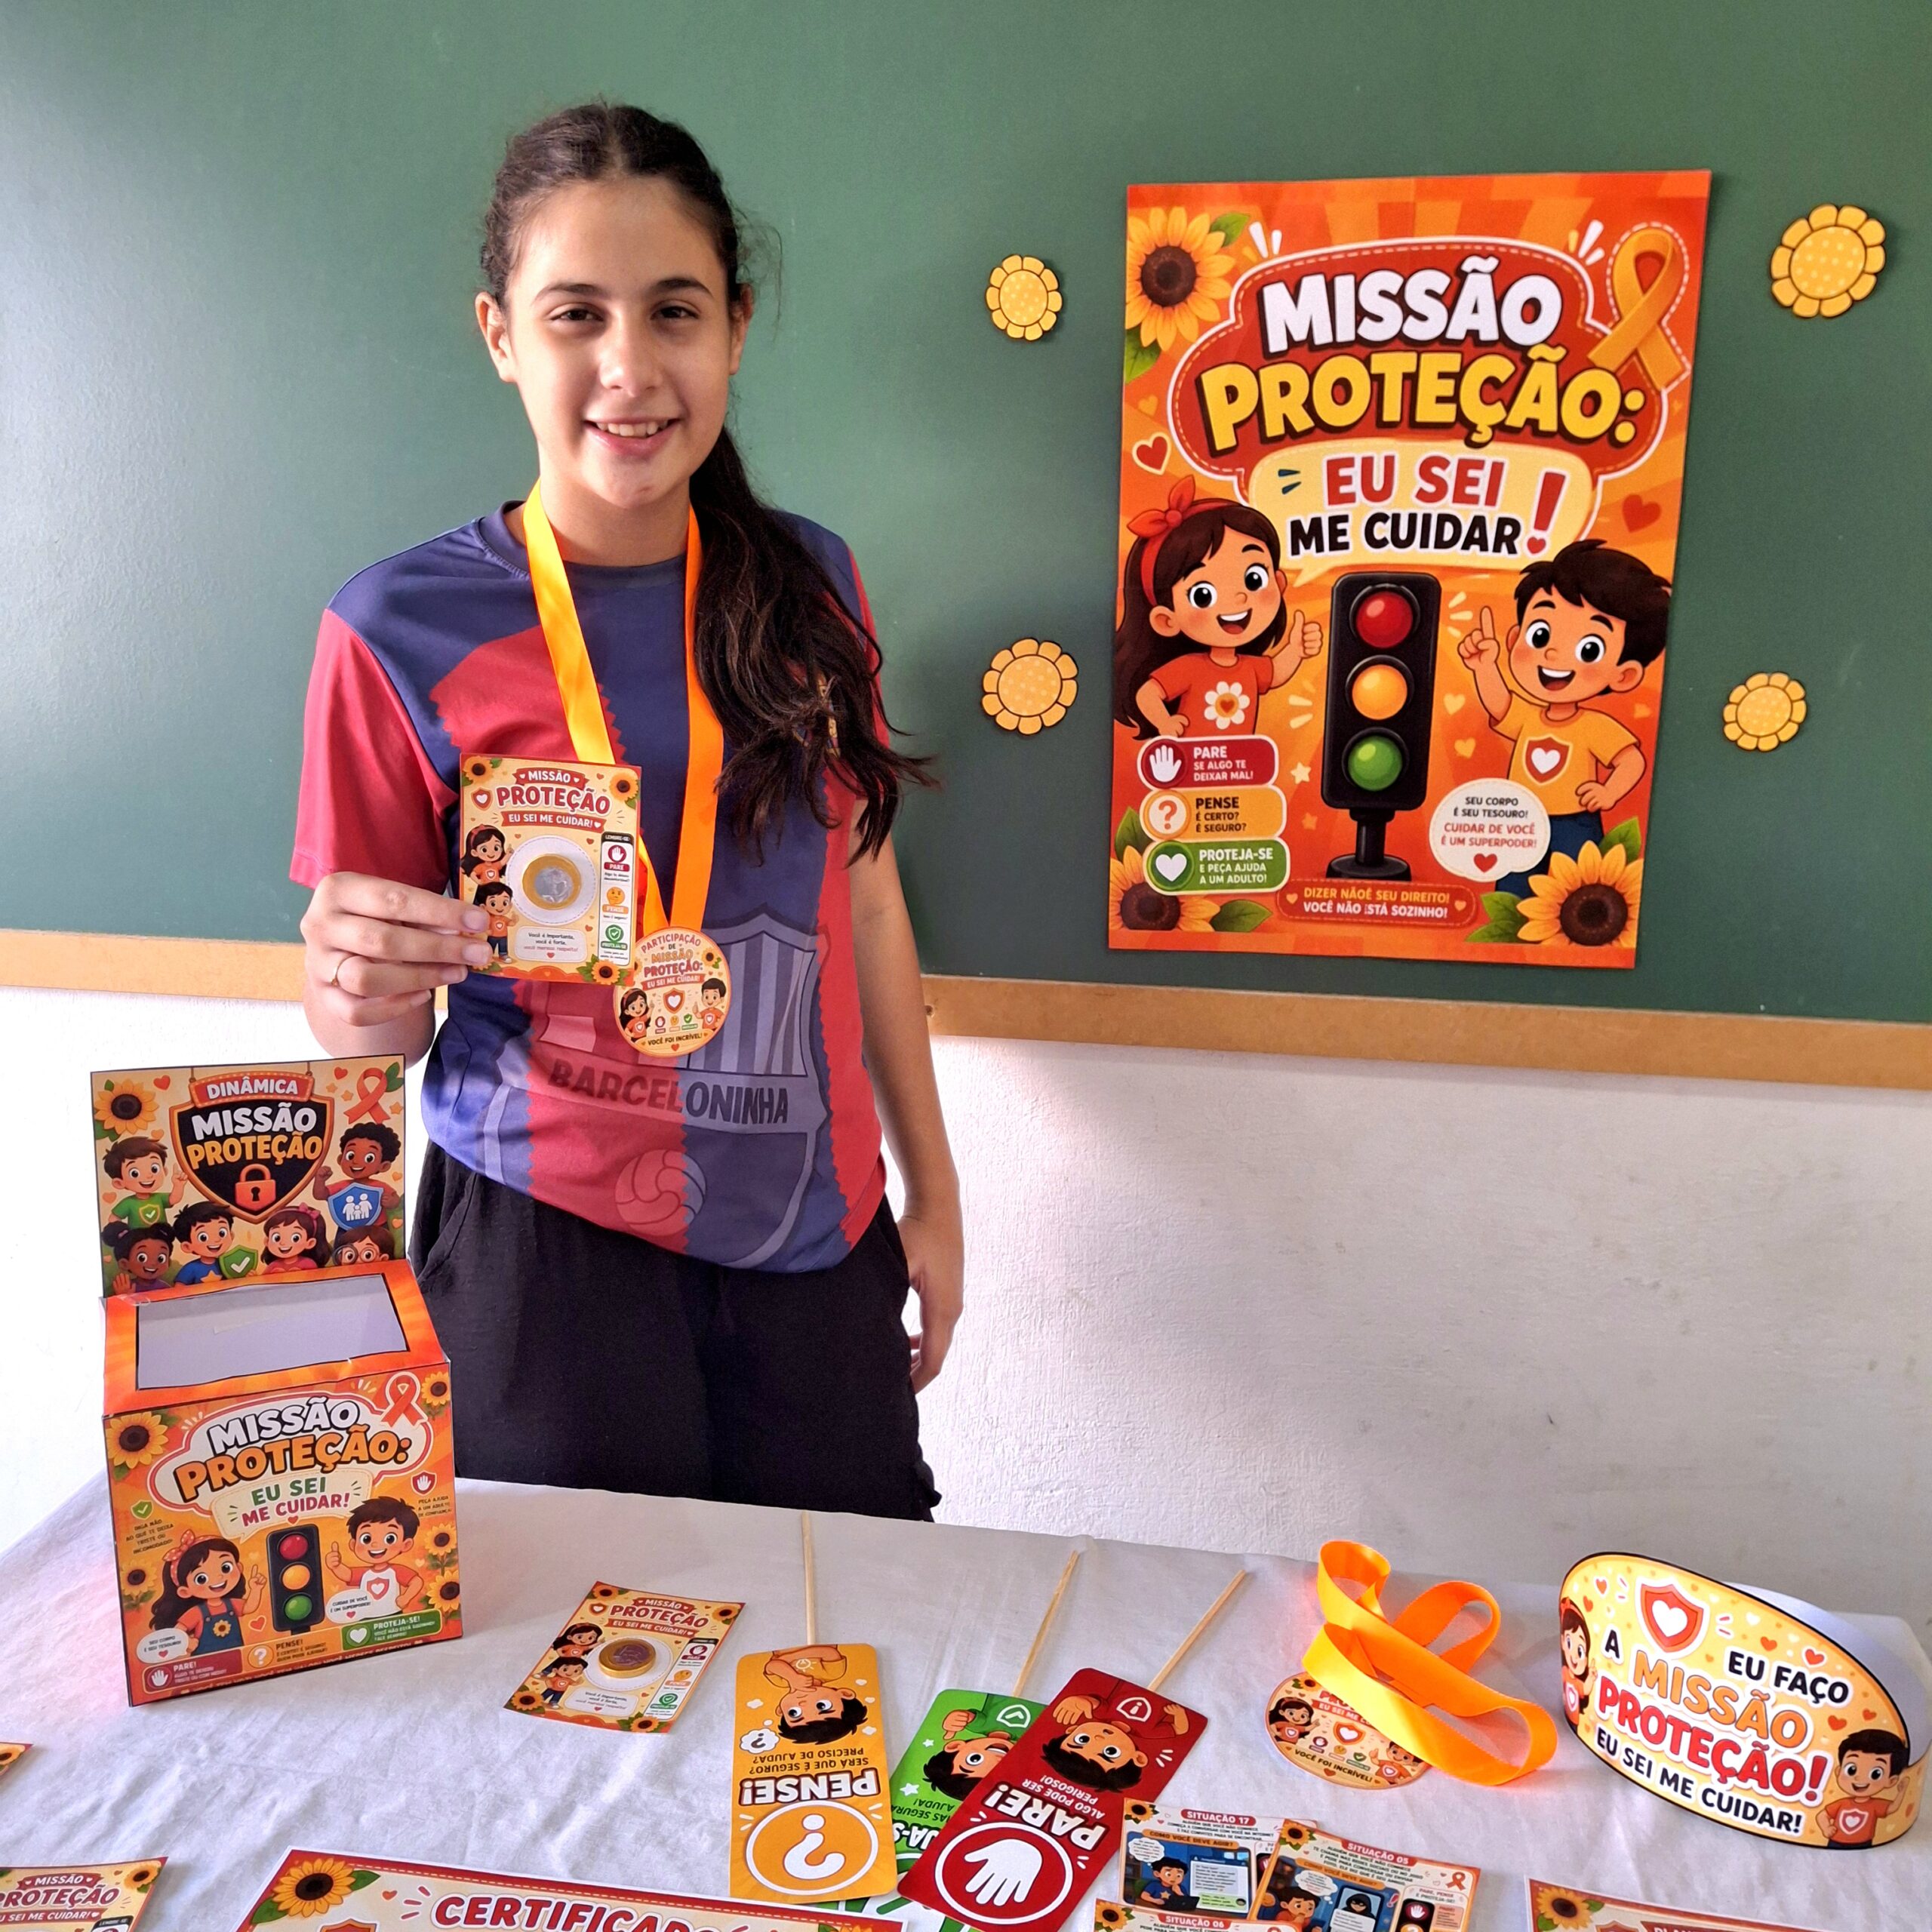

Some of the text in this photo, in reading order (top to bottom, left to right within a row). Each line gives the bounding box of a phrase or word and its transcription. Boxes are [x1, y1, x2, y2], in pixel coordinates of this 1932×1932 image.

[1262, 255, 1562, 352] MISSÃO
[1201, 346, 1646, 454] PROTEÇÃO:
[1325, 454, 1501, 507] EU SEI
[1290, 514, 1349, 555] ME
[1193, 746, 1227, 758] PARE
[1194, 760, 1246, 771] SE ALGO TE
[528, 770, 571, 783] MISSÃO
[1194, 771, 1254, 782] DEIXAR MAL!
[497, 786, 611, 814] PROTEÇÃO
[1195, 797, 1239, 809] PENSE
[1466, 797, 1518, 806] SEU CORPO
[1195, 811, 1238, 821] É CERTO?
[1454, 807, 1527, 818] É SEU TESOURO!
[509, 814, 593, 827] EU SEI ME CUIDAR!
[1196, 823, 1247, 832] É SEGURO?
[1444, 823, 1484, 833] CUIDAR
[1489, 824, 1503, 833] DE
[1441, 835, 1445, 844] É
[1469, 838, 1537, 848] SUPERPODER!
[1199, 848, 1273, 860] PROTEJA-SE
[1208, 863, 1232, 874] PEÇA
[1235, 863, 1266, 872] AJUDA
[1227, 875, 1266, 883] ADULTO!
[1304, 888, 1337, 898] DIZER
[1376, 891, 1397, 900] SEU
[1401, 891, 1450, 903] DIREITO!
[1304, 900, 1333, 913] VOCÊ
[1337, 901, 1361, 914] NÃO
[1392, 906, 1447, 918] SOZINHO!
[641, 934, 701, 953] PARTICIPAÇÃO
[651, 948, 694, 963] MISSÃO
[676, 1033, 702, 1042] INCRÍVEL!
[207, 1076, 298, 1100] DINÂMICA
[191, 1102, 317, 1140] MISSÃO
[186, 1131, 323, 1171] PROTEÇÃO
[208, 1396, 360, 1454] MISSÃO
[174, 1425, 411, 1501] PROTEÇÃO:
[251, 1476, 327, 1506] EU SEI
[242, 1493, 350, 1527] ME CUIDAR!
[645, 1599, 682, 1609] MISSÃO
[374, 1616, 420, 1630] PROTEJA-SE!
[610, 1605, 709, 1627] PROTEÇÃO
[654, 1624, 687, 1635] CUIDAR!
[276, 1639, 303, 1650] PENSE!
[174, 1662, 196, 1672] PARE!
[1728, 1651, 1850, 1705] EU FAÇO
[1604, 1629, 1808, 1749] A MISSÃO
[1598, 1675, 1828, 1802] PROTEÇÃO!
[752, 1747, 863, 1764] PRECISO DE AJUDA?
[749, 1757, 869, 1775] SERÁ QUE É SEGURO?
[1294, 1749, 1316, 1761] VOCÊ
[1318, 1758, 1333, 1767] FOI
[1334, 1764, 1373, 1783] INCRÍVEL!
[740, 1769, 880, 1805] PENSE!
[1596, 1727, 1802, 1834] EU SEI ME CUIDAR!
[1040, 1775, 1098, 1805] PERIGOSO!
[913, 1798, 955, 1811] AJUDA!
[1022, 1778, 1106, 1820] ALGO PODE SER
[932, 1813, 950, 1823] AS
[984, 1783, 1107, 1850] PARE!
[1186, 1811, 1236, 1823] SITUAÇÃO
[1348, 1843, 1395, 1861] SITUAÇÃO
[35, 1874, 84, 1885] MISSÃO
[47, 1912, 91, 1920] CUIDAR!
[1166, 1915, 1210, 1927] SITUAÇÃO
